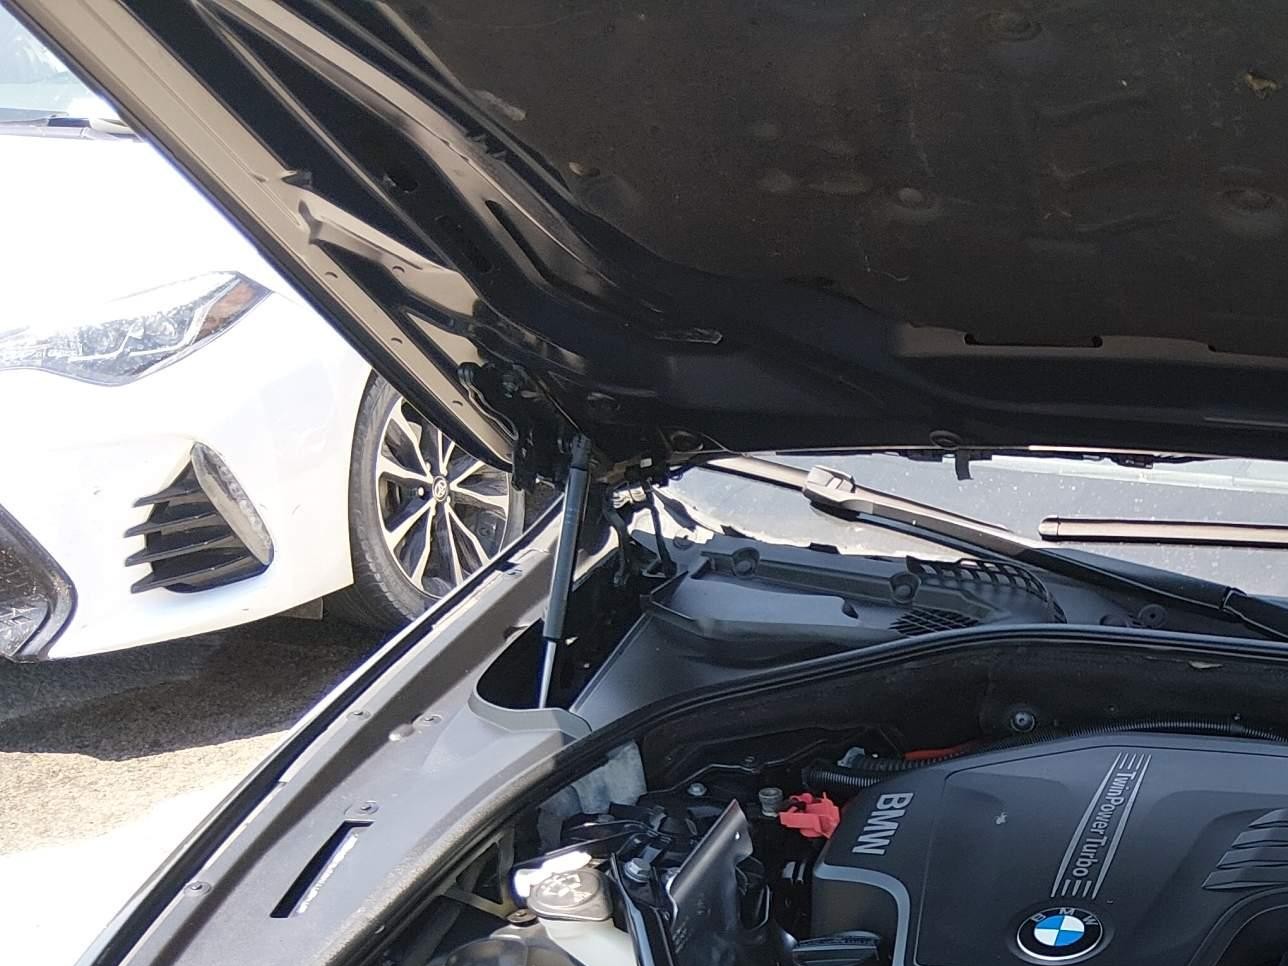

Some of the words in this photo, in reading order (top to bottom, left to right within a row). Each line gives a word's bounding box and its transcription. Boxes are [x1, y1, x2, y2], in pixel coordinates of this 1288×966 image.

[851, 792, 914, 855] BMW
[1090, 771, 1137, 835] TwinPower
[1072, 836, 1108, 877] Turbo
